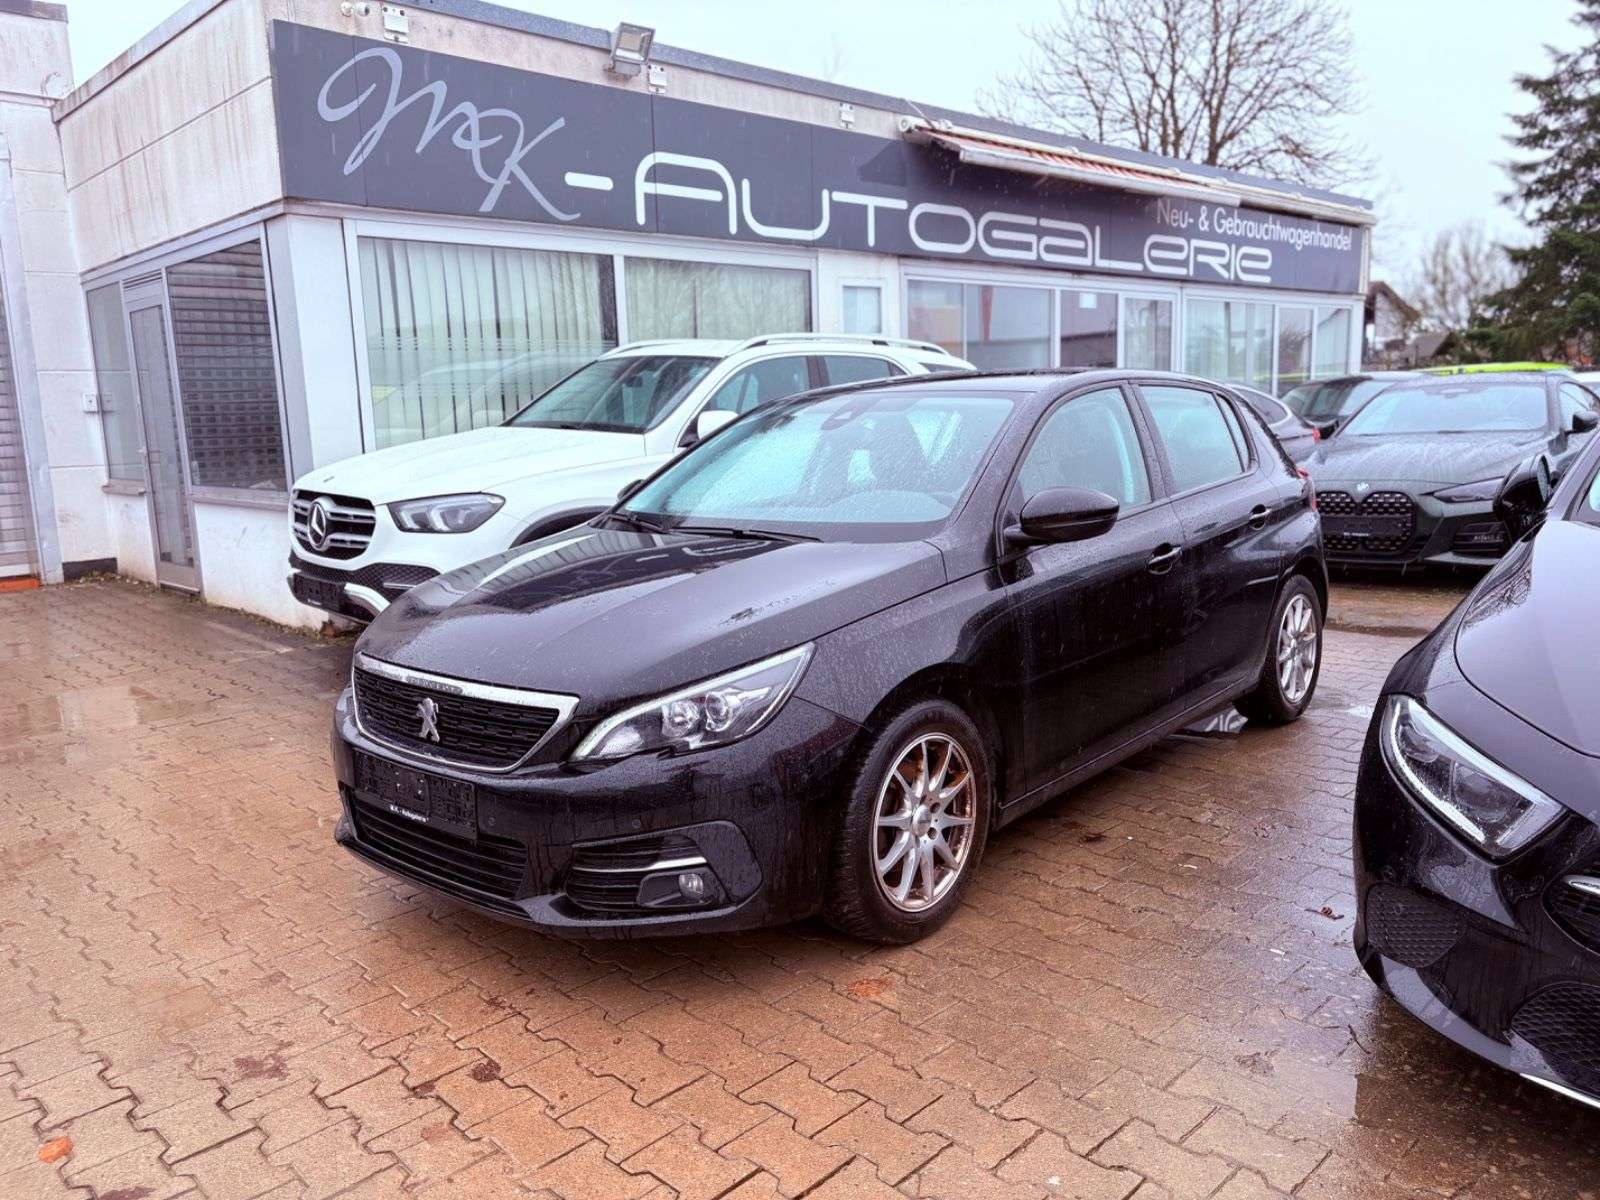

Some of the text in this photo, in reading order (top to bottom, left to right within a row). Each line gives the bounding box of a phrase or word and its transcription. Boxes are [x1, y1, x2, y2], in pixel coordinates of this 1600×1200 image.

[1156, 198, 1352, 251] Neu- & Gebrauchtwagenhandel
